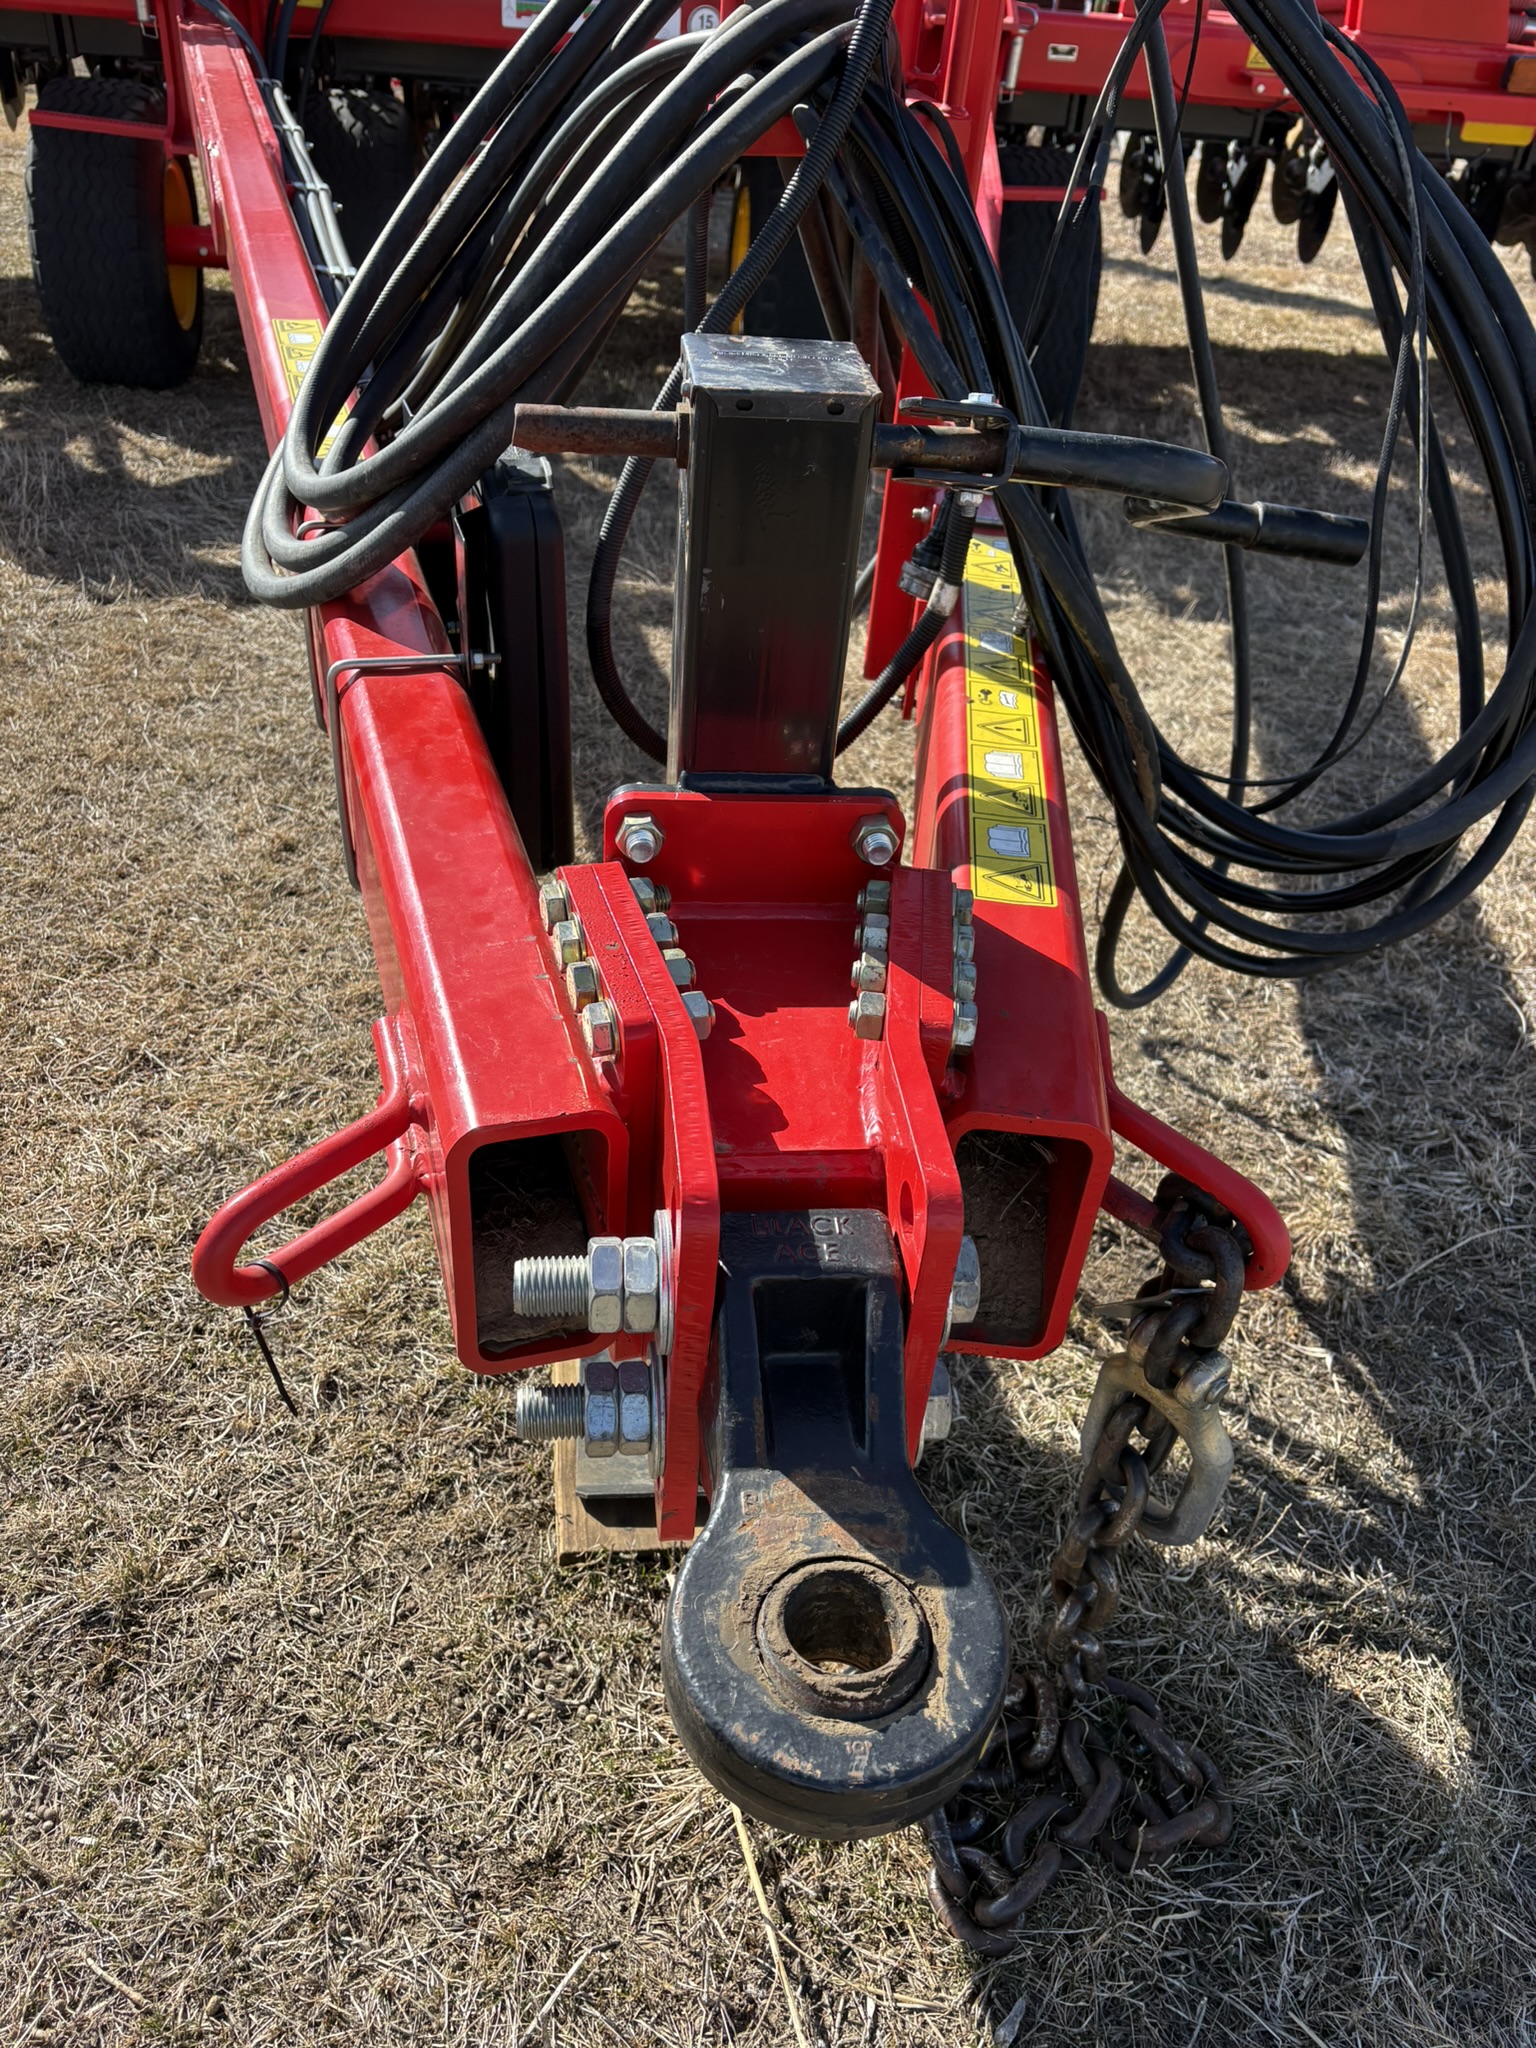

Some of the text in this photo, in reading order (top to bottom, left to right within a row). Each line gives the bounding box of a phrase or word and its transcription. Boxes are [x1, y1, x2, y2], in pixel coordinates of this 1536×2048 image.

[699, 13, 714, 30] 15
[751, 1215, 855, 1237] BLACK
[774, 1241, 840, 1263] ACE
